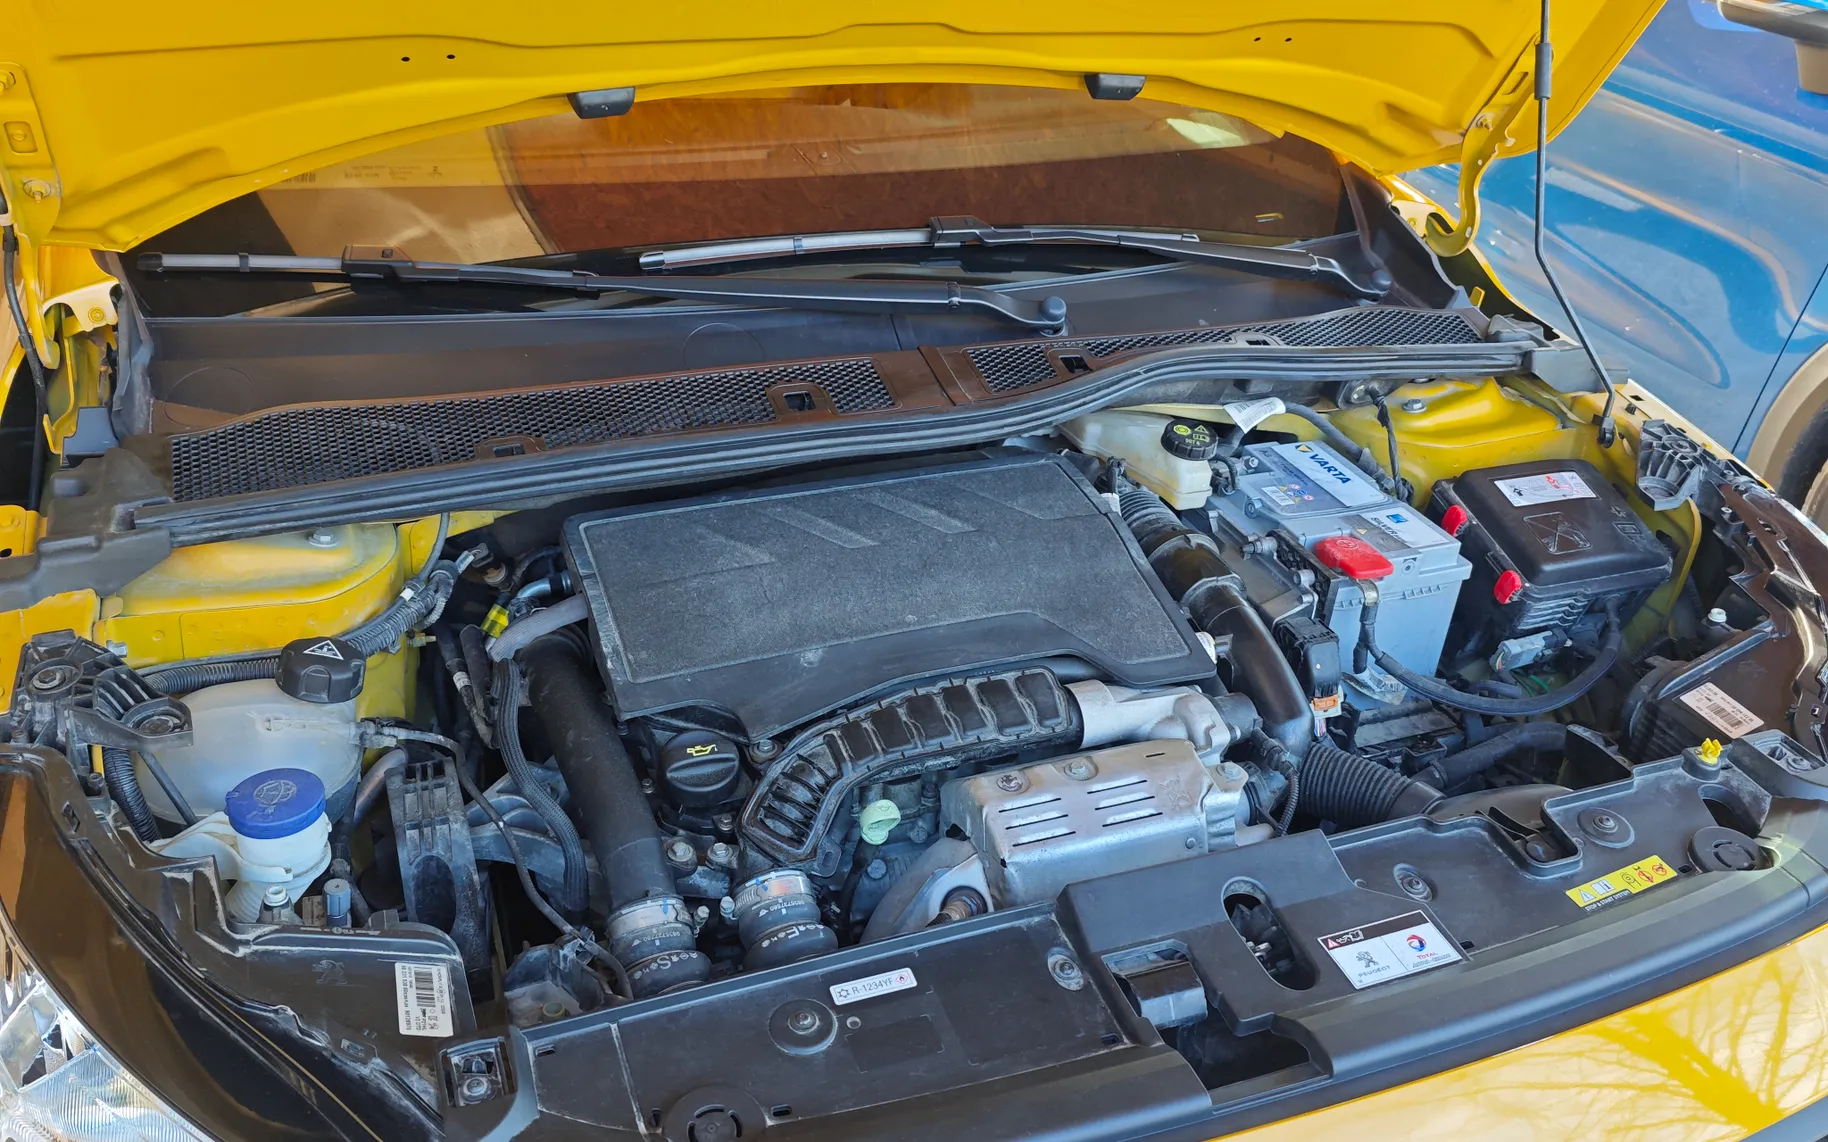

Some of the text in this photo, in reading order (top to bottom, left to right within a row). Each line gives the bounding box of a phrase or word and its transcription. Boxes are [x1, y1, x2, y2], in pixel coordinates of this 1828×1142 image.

[1309, 453, 1352, 485] VARTA
[1370, 516, 1398, 536] SILVER
[1585, 902, 1598, 912] STOP
[1601, 896, 1615, 905] START
[1614, 890, 1631, 900] SYSTEM
[656, 953, 672, 970] S
[1416, 951, 1438, 960] TOTAL
[1358, 965, 1391, 978] PEUGEOT
[851, 977, 894, 995] R-1234YF
